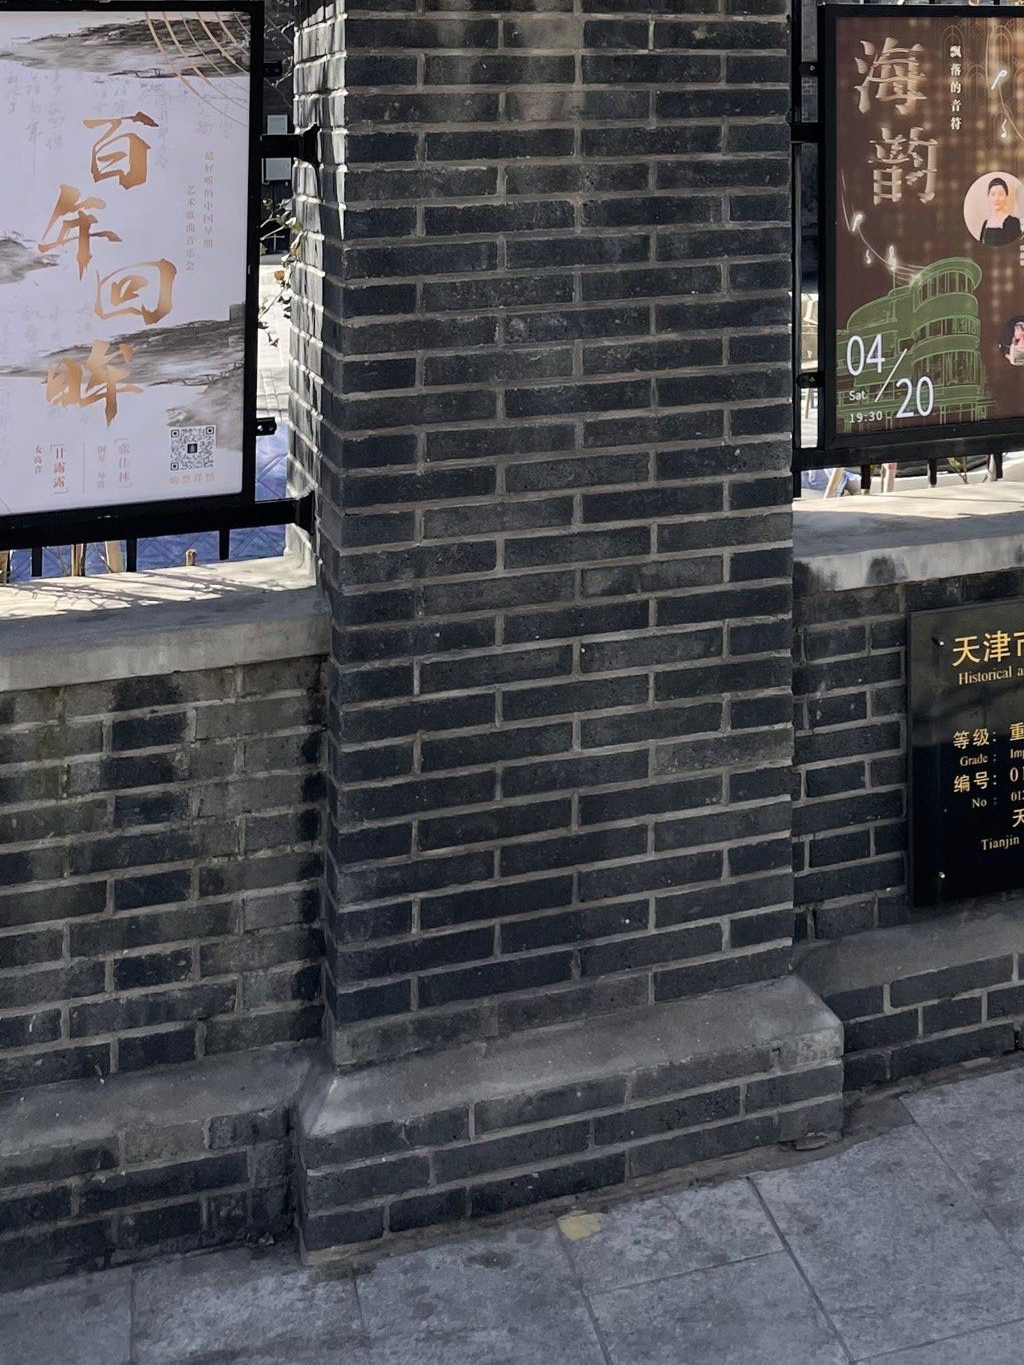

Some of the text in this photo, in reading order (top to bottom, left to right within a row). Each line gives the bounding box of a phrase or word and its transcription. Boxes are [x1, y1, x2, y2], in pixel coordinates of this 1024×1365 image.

[949, 45, 962, 130] 飘落的音符
[37, 111, 177, 428] 百年回眸
[846, 334, 886, 376] 04
[848, 410, 883, 424] 19:30
[895, 375, 934, 418] 20
[958, 666, 1013, 686] Historical
[980, 835, 1021, 852] Tianjin
